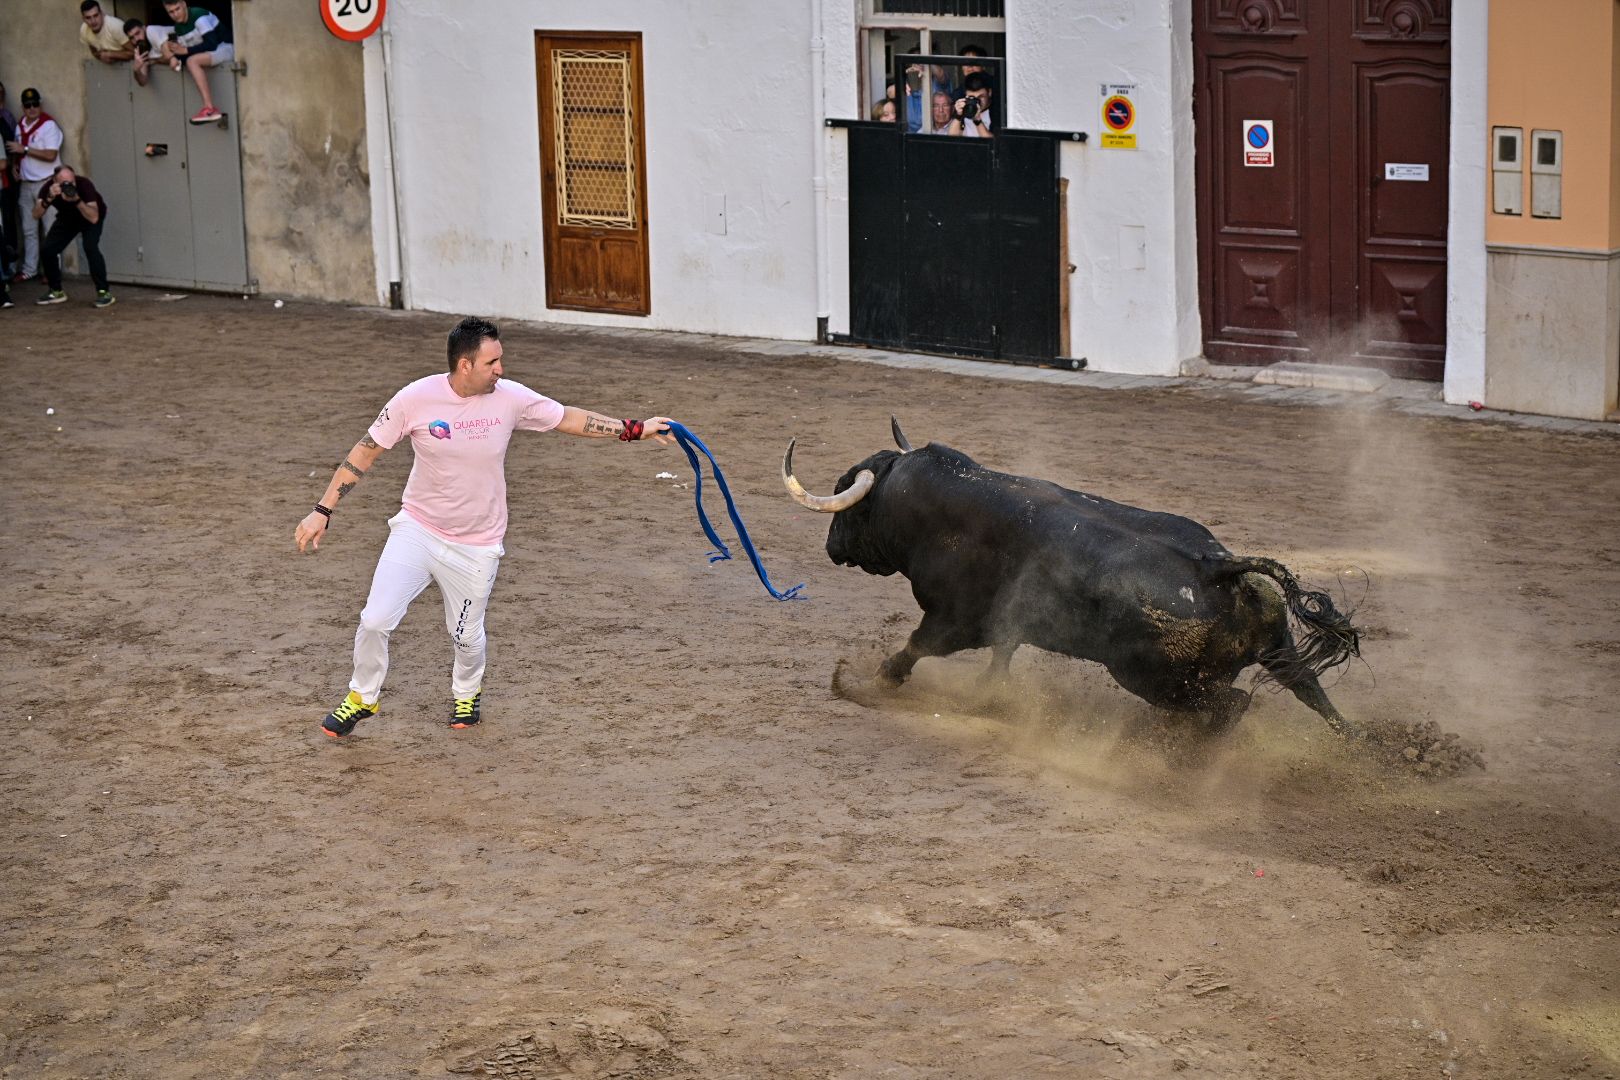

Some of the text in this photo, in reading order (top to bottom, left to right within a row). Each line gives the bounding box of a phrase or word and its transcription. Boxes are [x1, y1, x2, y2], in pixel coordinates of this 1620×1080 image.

[335, 0, 371, 17] 20
[454, 417, 501, 429] QUARELLA
[454, 598, 472, 641] OLUCHA
